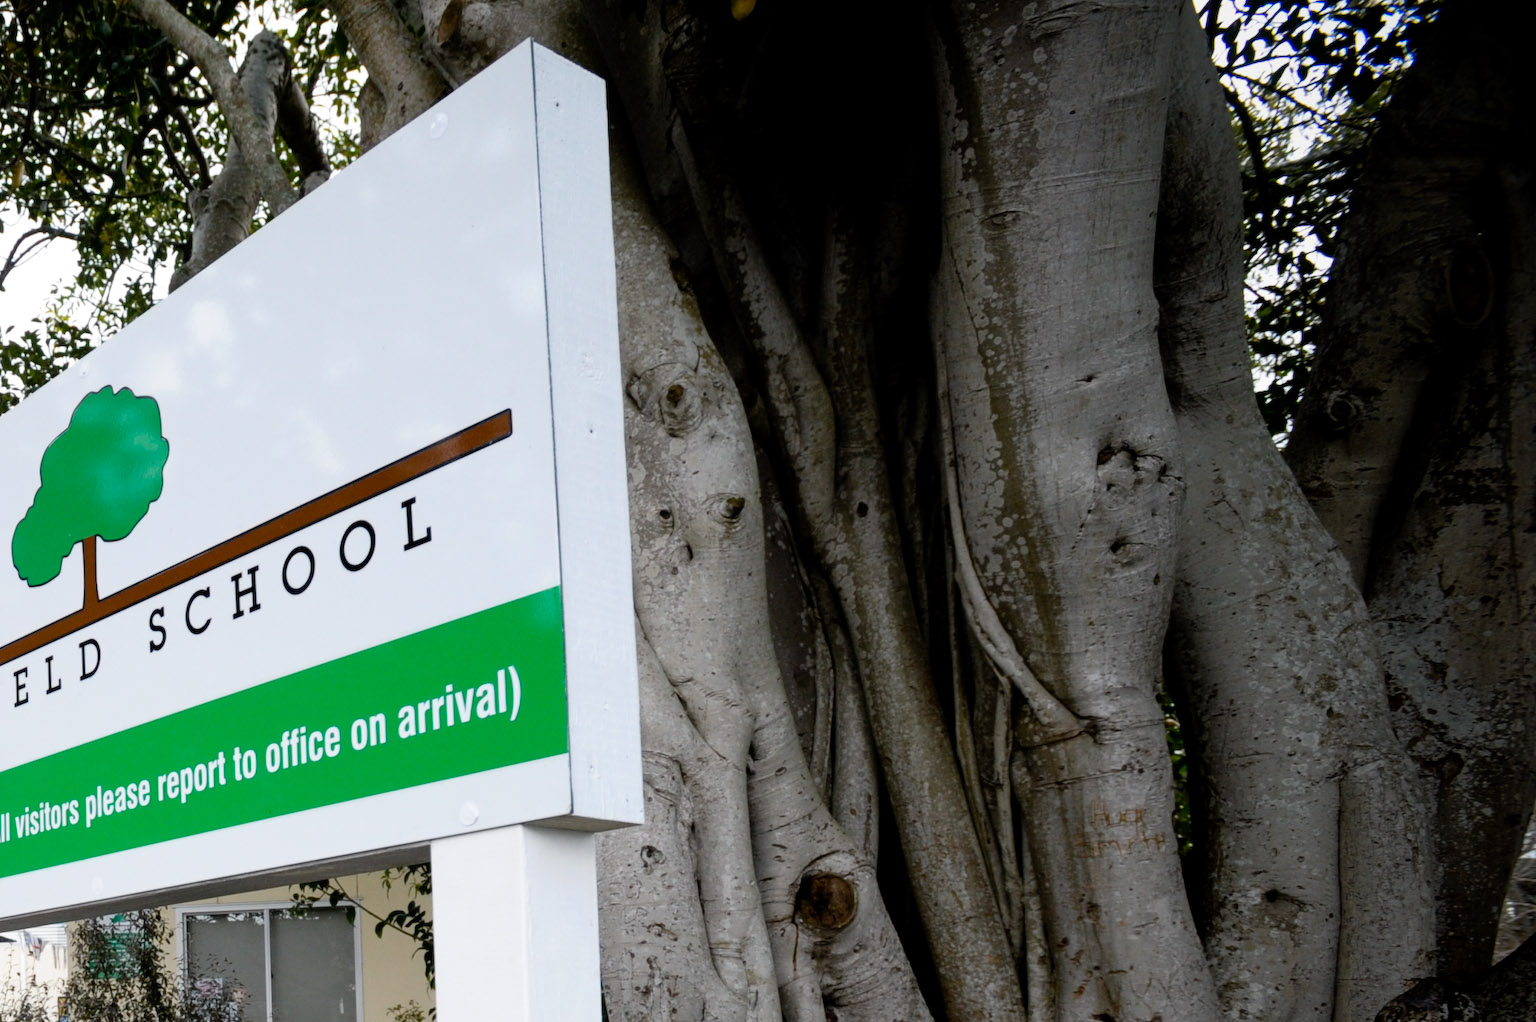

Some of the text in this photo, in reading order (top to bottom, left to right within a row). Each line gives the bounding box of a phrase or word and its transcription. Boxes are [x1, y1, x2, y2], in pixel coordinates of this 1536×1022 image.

[148, 496, 432, 653] SCHOOL
[14, 799, 80, 839] visitors
[85, 779, 152, 830] please
[157, 751, 227, 804] report
[232, 746, 257, 782] to
[265, 728, 341, 774] office
[350, 712, 387, 751] on
[397, 665, 522, 740] arrival)
